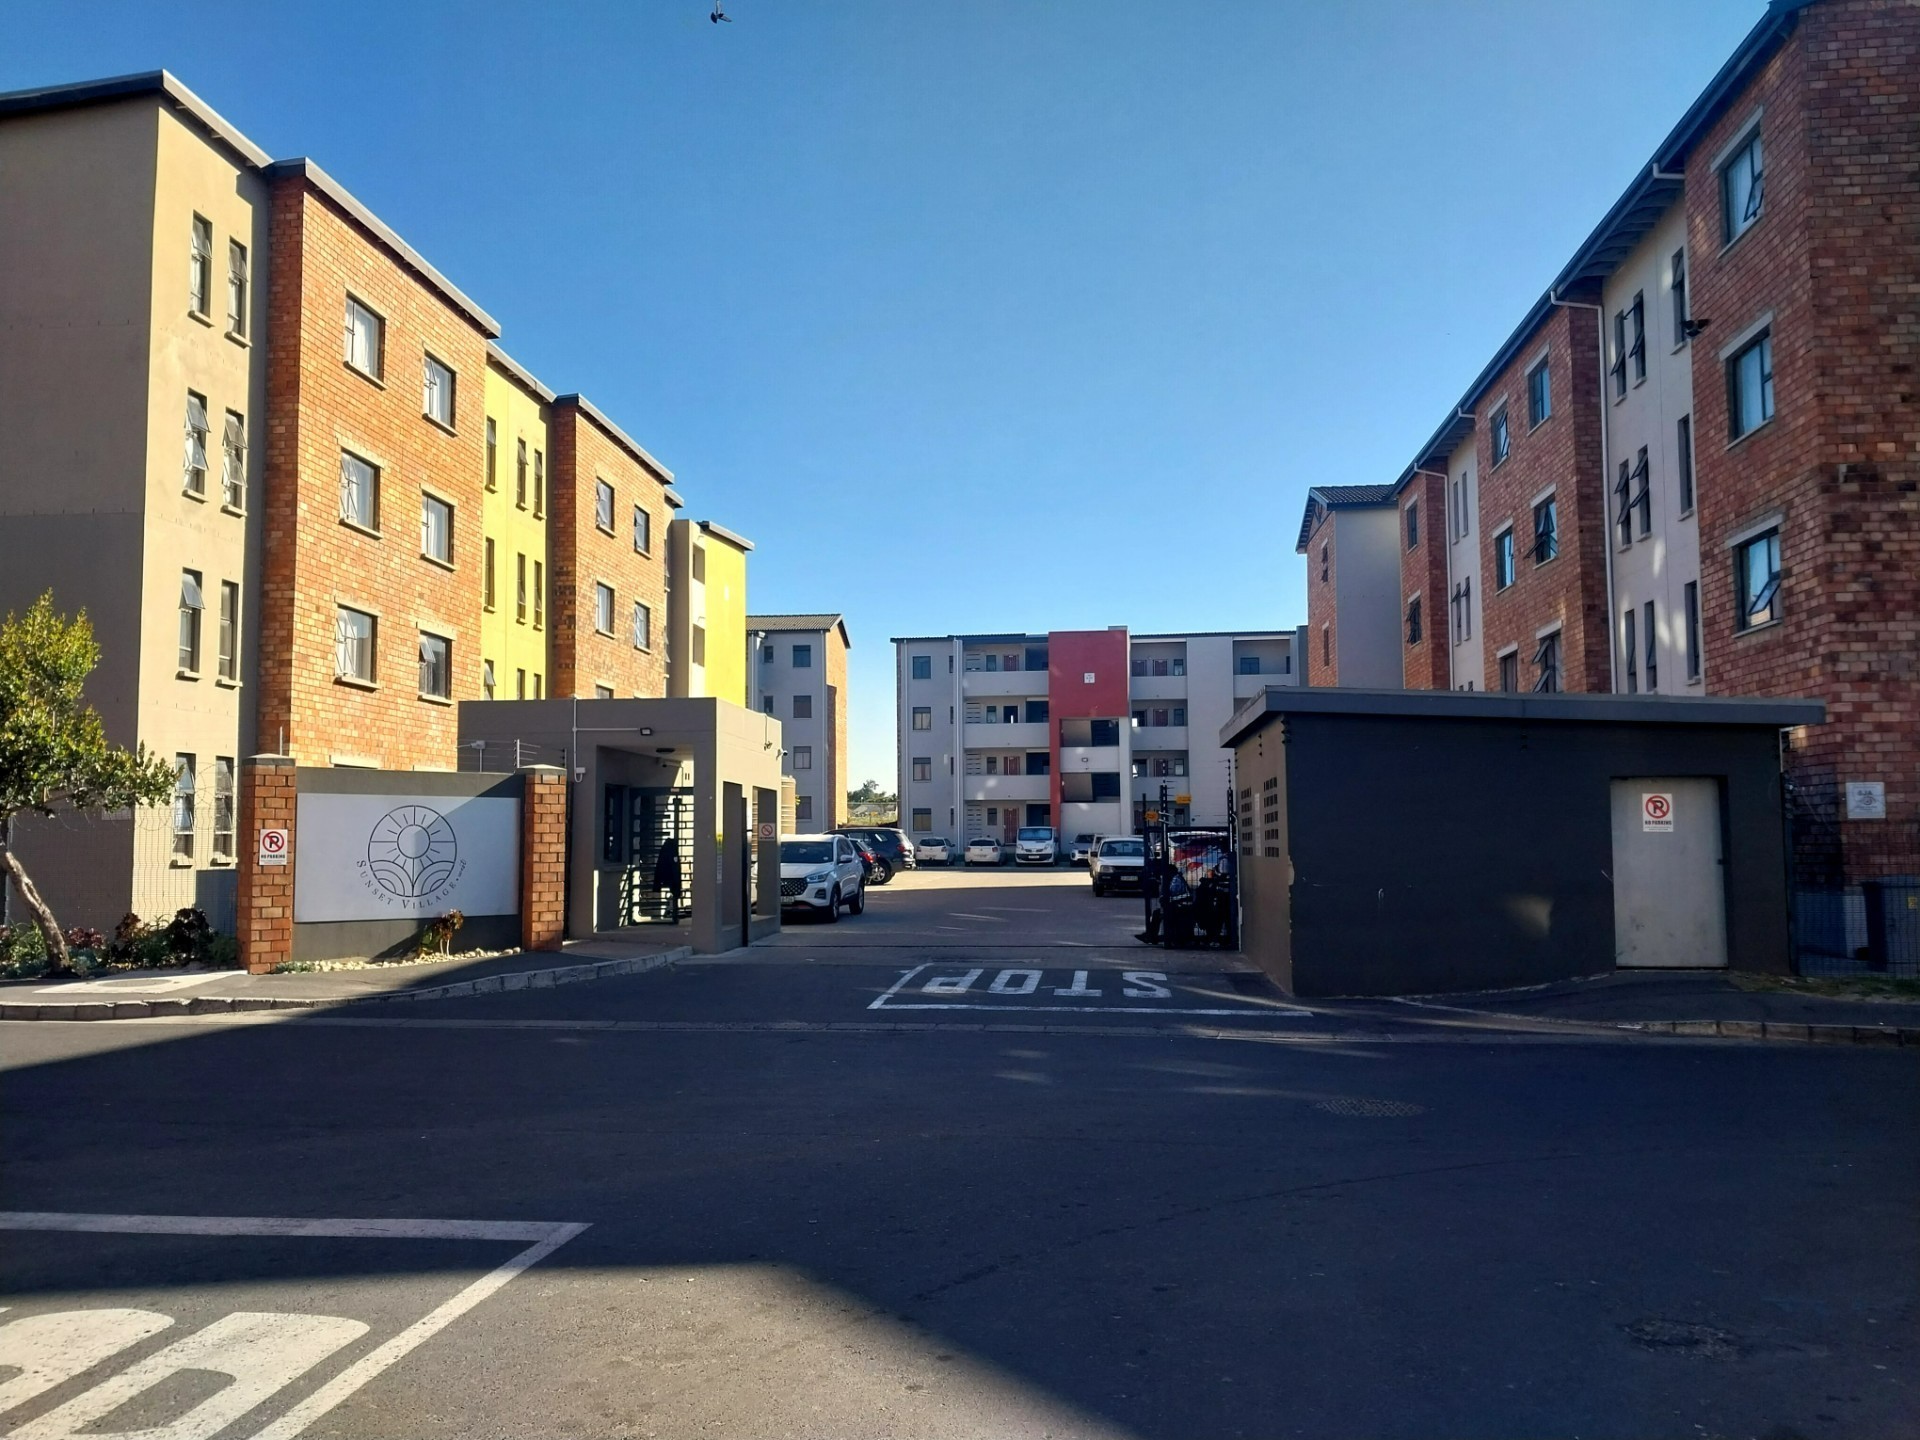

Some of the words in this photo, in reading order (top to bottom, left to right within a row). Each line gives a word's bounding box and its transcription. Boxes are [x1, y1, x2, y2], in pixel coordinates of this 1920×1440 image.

[357, 860, 394, 905] SUNSET
[402, 883, 457, 909] VILLAGE
[921, 968, 1172, 998] STOP
